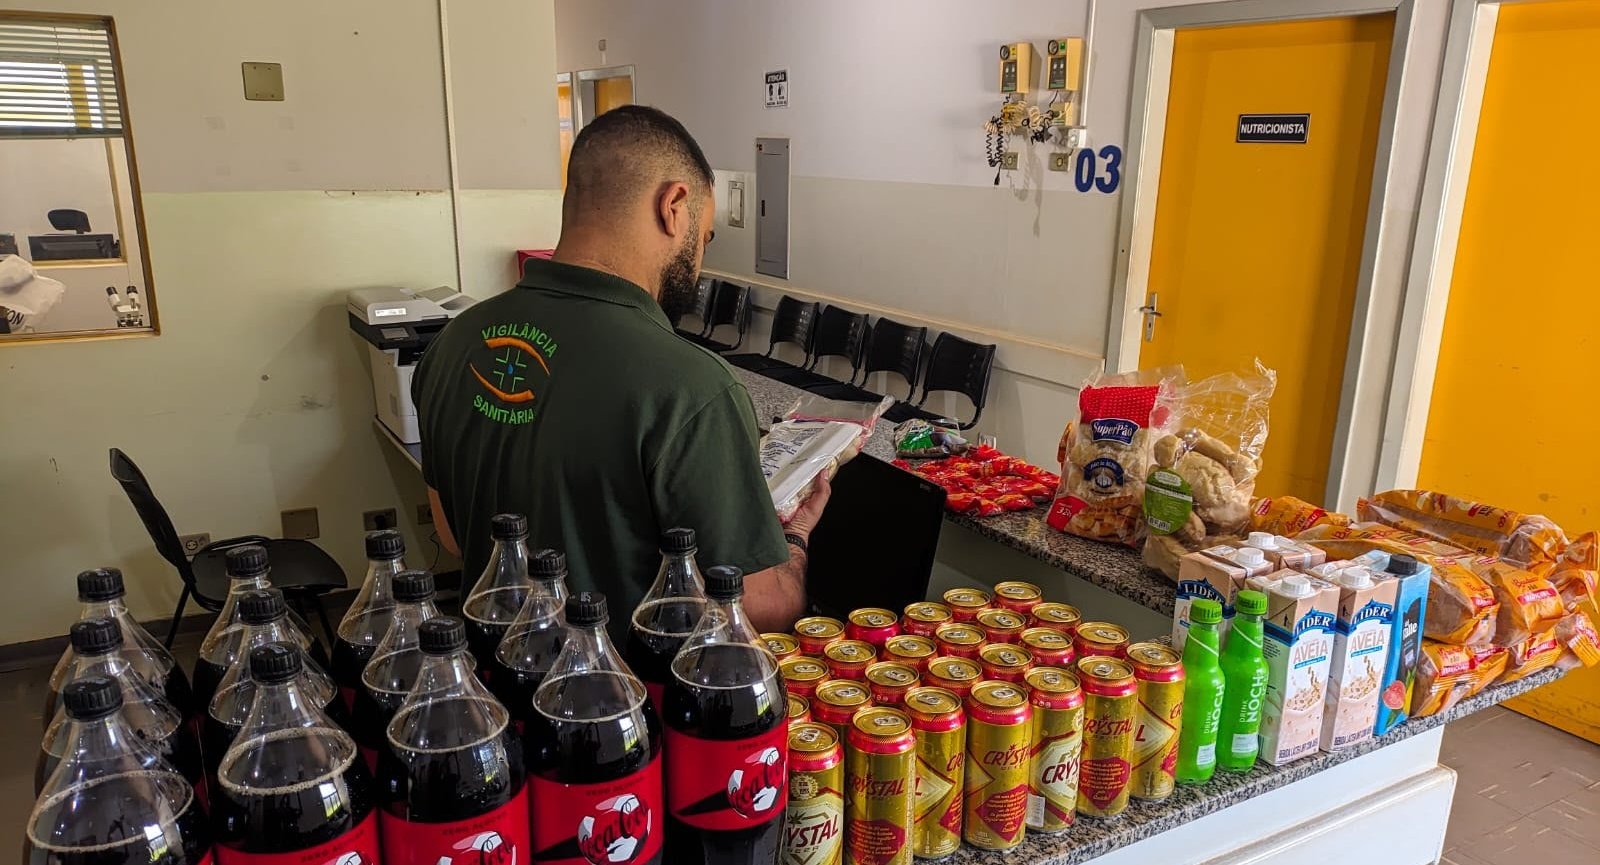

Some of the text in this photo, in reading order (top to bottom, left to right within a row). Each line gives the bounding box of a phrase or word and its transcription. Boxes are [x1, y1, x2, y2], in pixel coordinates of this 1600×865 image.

[1240, 123, 1305, 134] NUTRICIONISTA
[1074, 144, 1123, 194] 03
[481, 322, 557, 358] VIGILÂNCIA
[473, 394, 534, 425] SANITÁRIA
[1093, 421, 1133, 437] SuperPão
[1294, 615, 1332, 637] LIDER
[1353, 606, 1390, 626] LIDER
[983, 744, 1030, 767] CRYST
[1041, 754, 1079, 784] CRYS
[787, 814, 839, 848] YSTAL
